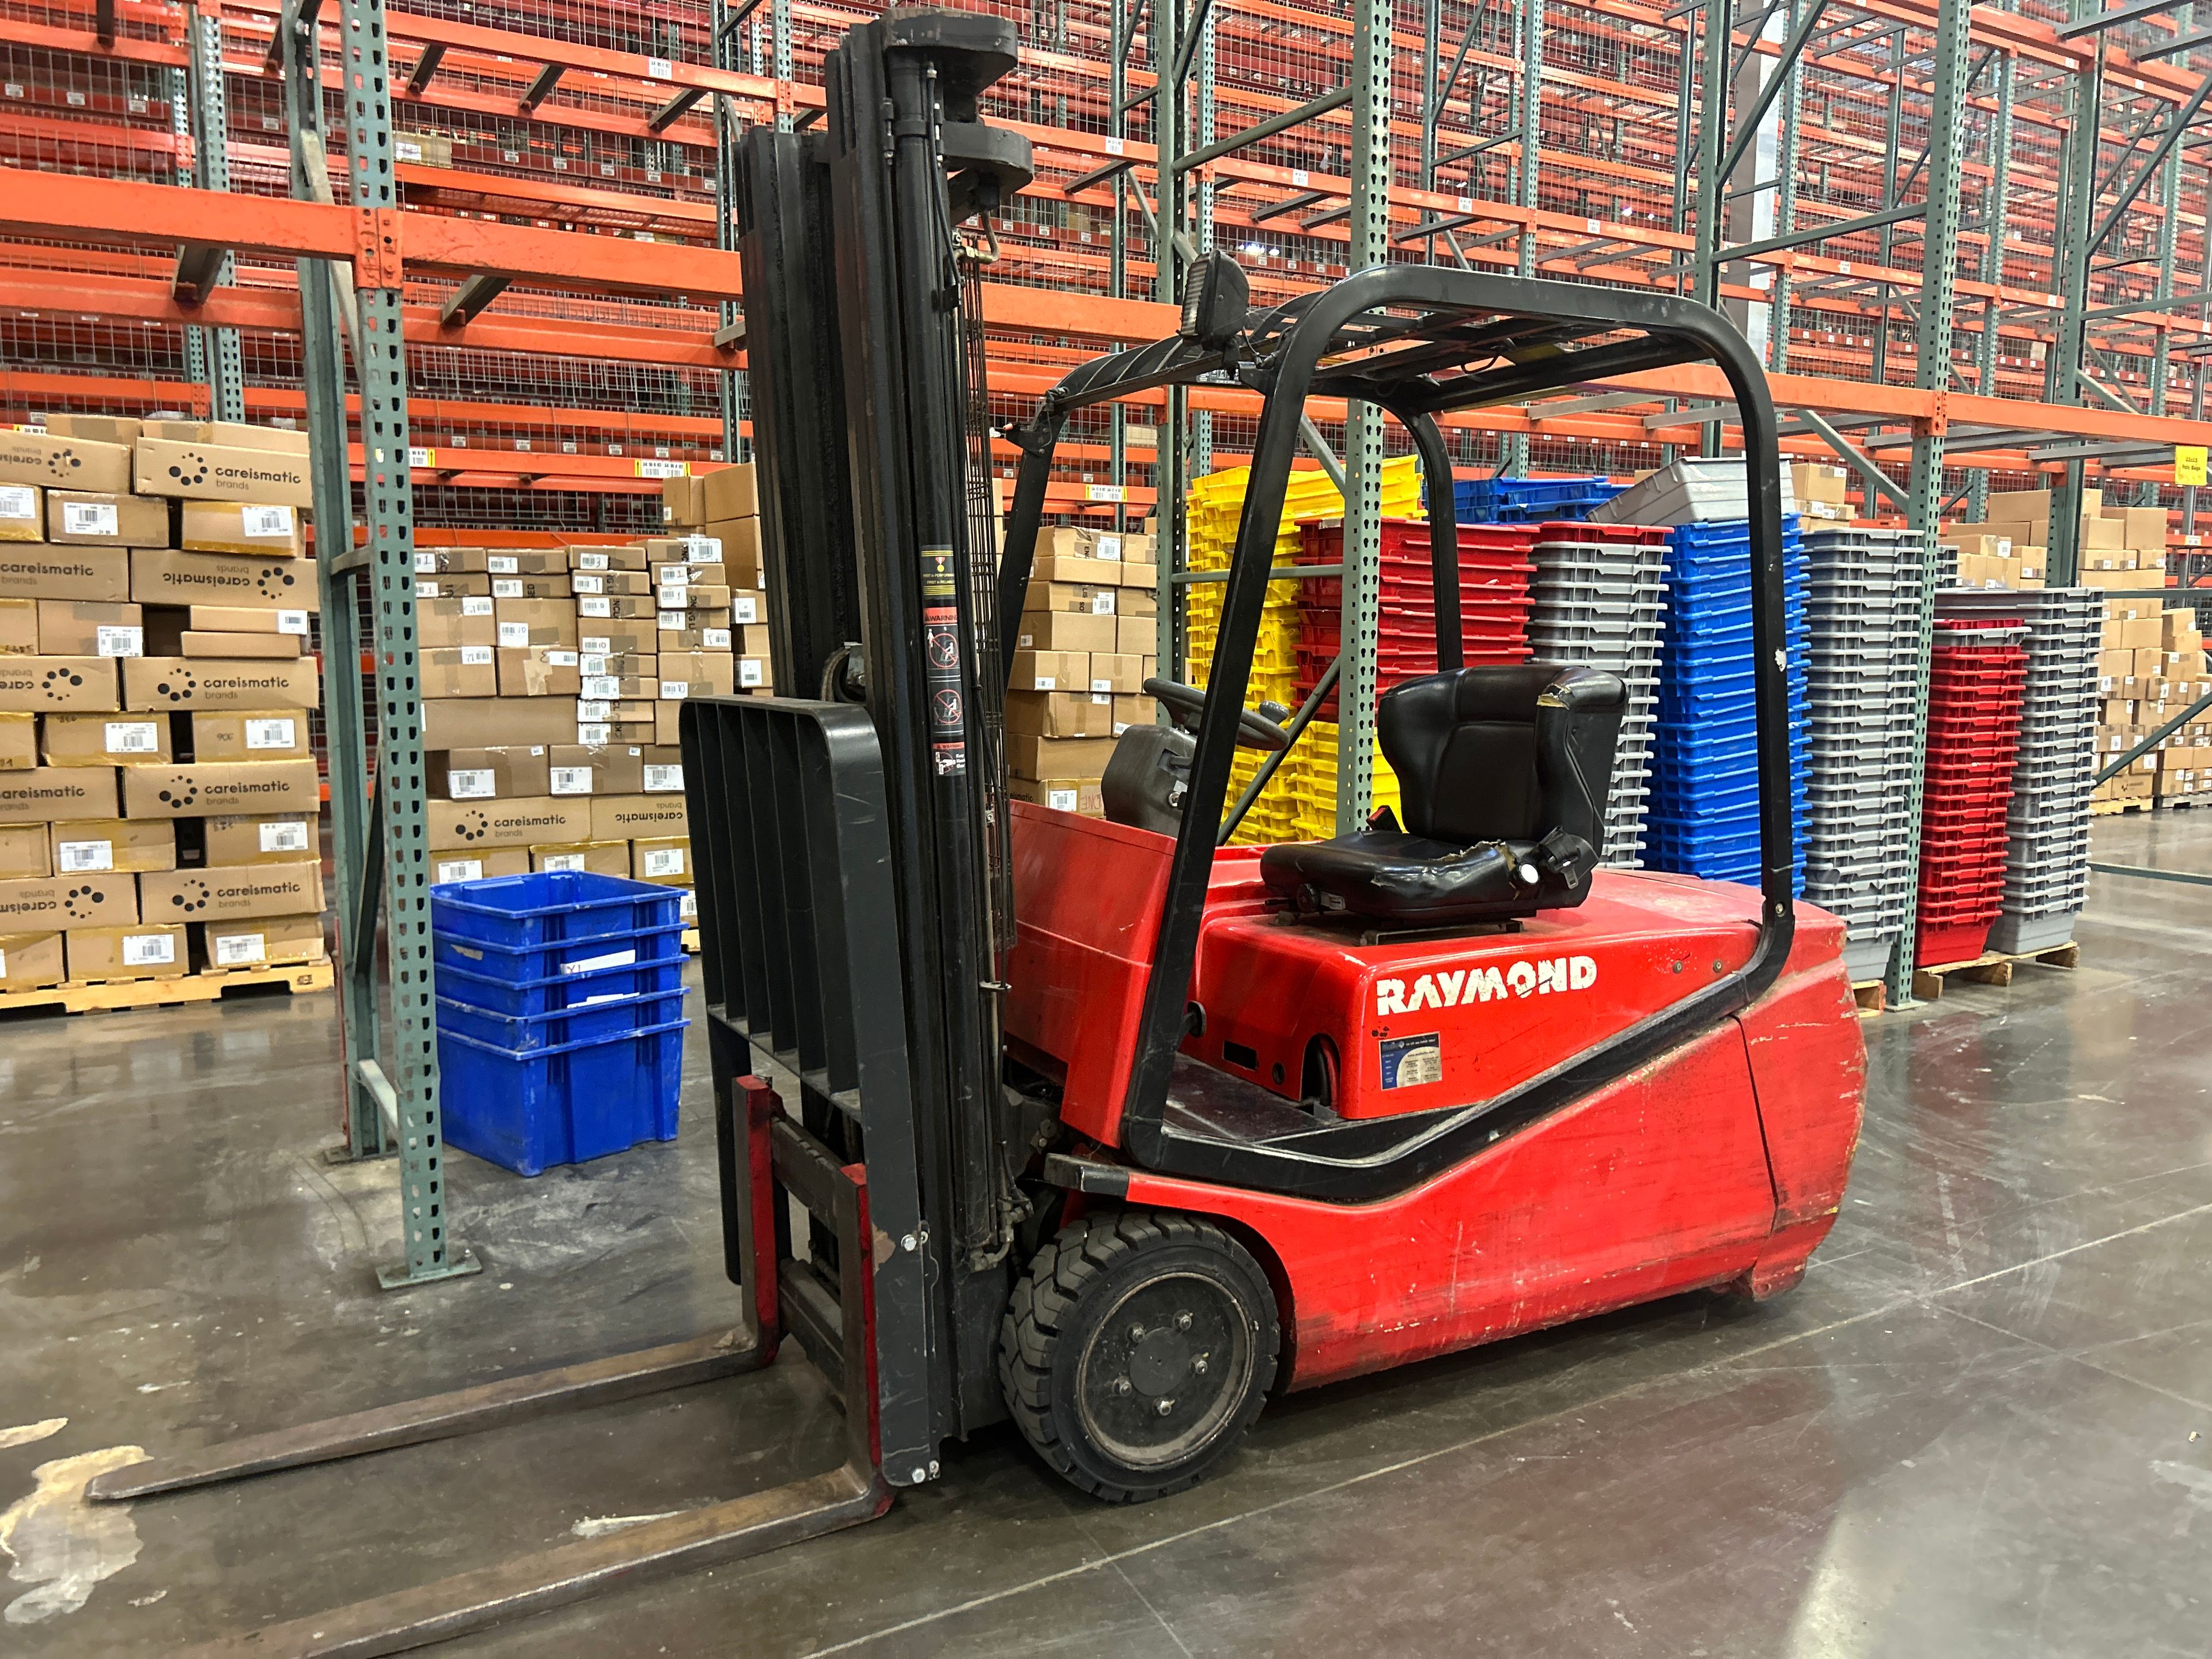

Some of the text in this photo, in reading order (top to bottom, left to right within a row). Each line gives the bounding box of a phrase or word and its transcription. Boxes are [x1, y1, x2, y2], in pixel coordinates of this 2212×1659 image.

[215, 467, 301, 484] careismatic
[216, 479, 249, 490] brands
[0, 562, 94, 576] careismatic
[216, 565, 249, 574] brands
[163, 573, 251, 588] careismatic
[204, 676, 289, 688] careismatic
[205, 691, 238, 699] brands
[0, 786, 85, 800] areismatic
[205, 781, 290, 794] careismatic
[206, 797, 239, 805] brands
[656, 802, 683, 810] brands
[494, 814, 566, 828] careismatic
[615, 812, 683, 823] careismatic
[495, 829, 523, 838] brands
[217, 882, 301, 897] careismatic
[219, 899, 251, 908] brands
[1376, 955, 1597, 1016] RAYMOND
